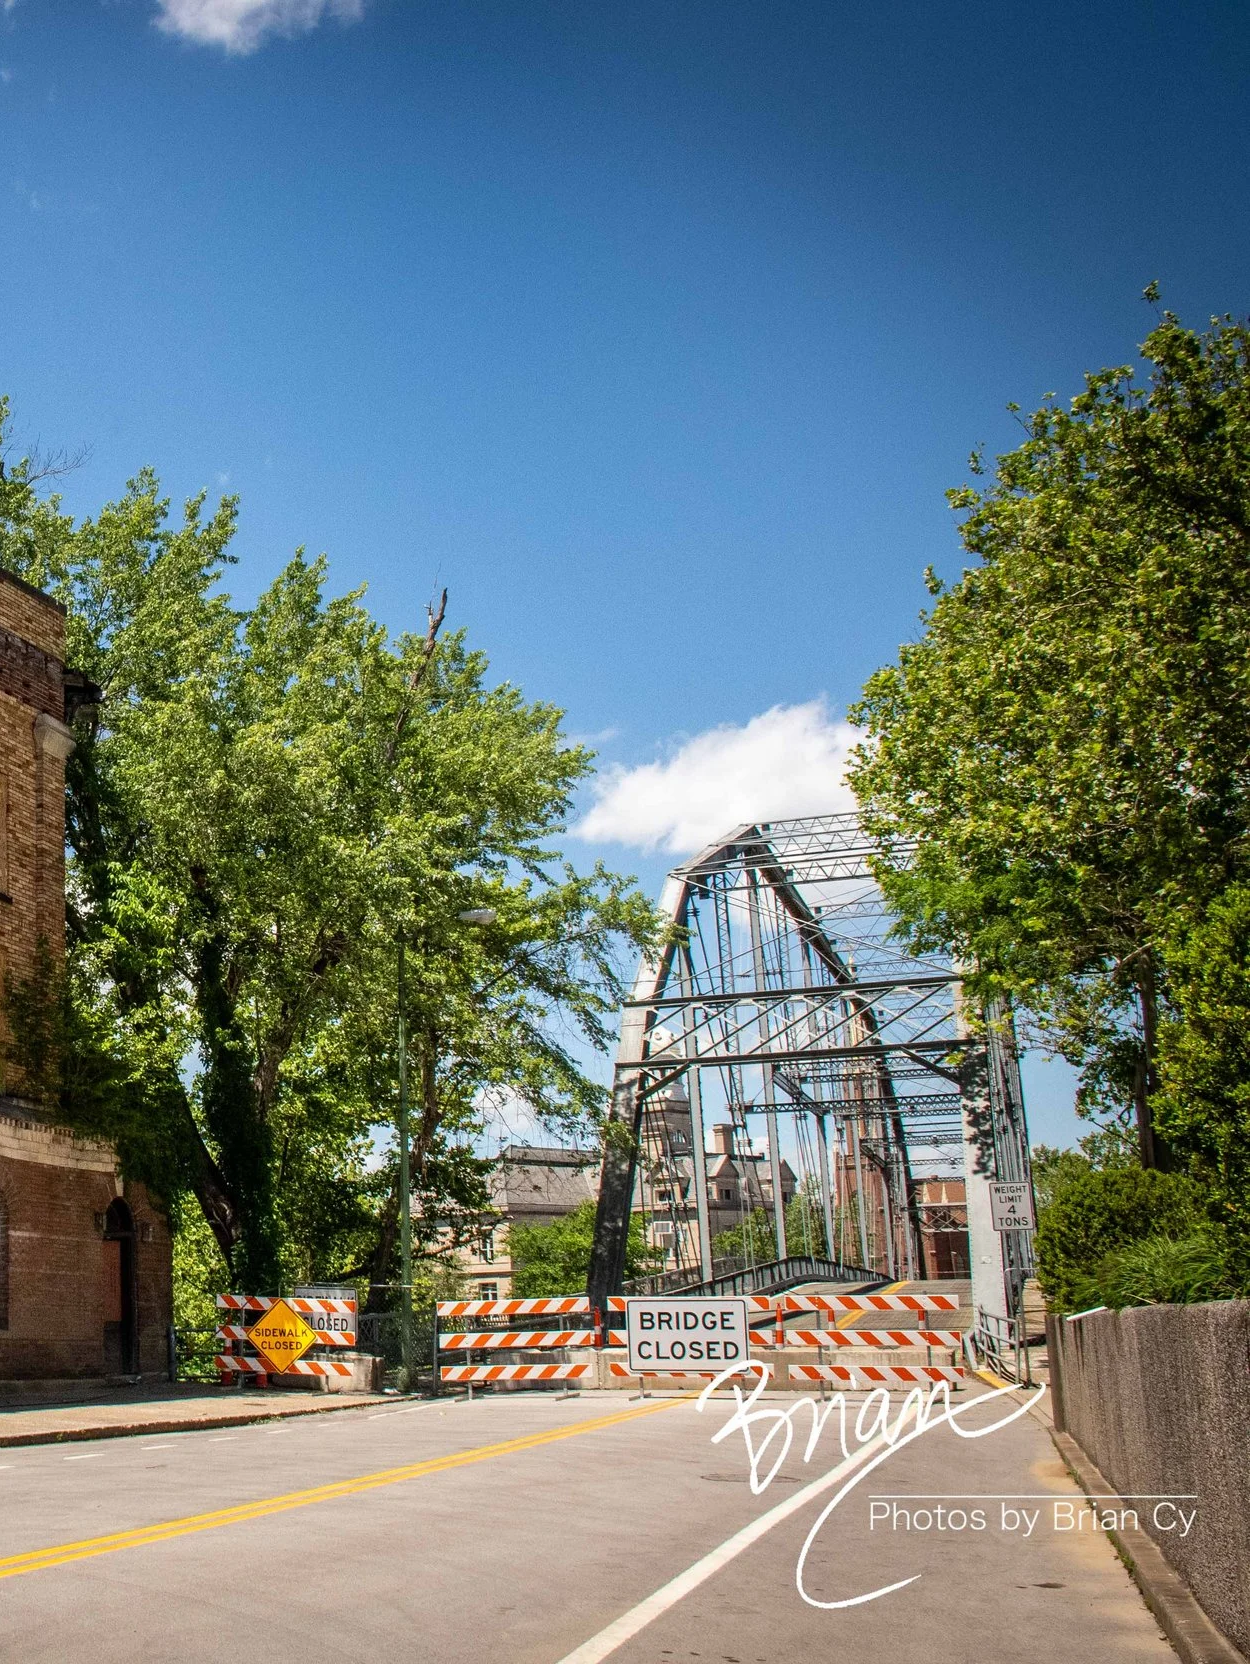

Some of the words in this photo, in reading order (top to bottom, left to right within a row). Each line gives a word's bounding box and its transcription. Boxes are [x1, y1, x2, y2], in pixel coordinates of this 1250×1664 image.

[993, 1185, 1027, 1194] WEIGHT
[999, 1195, 1022, 1203] LIMIT
[1007, 1204, 1017, 1215] 4
[997, 1216, 1029, 1227] TONS
[639, 1311, 736, 1330] BRIDGE
[254, 1328, 308, 1338] SIDEWALK
[260, 1340, 303, 1350] CLOSED
[637, 1340, 739, 1360] CLOSED
